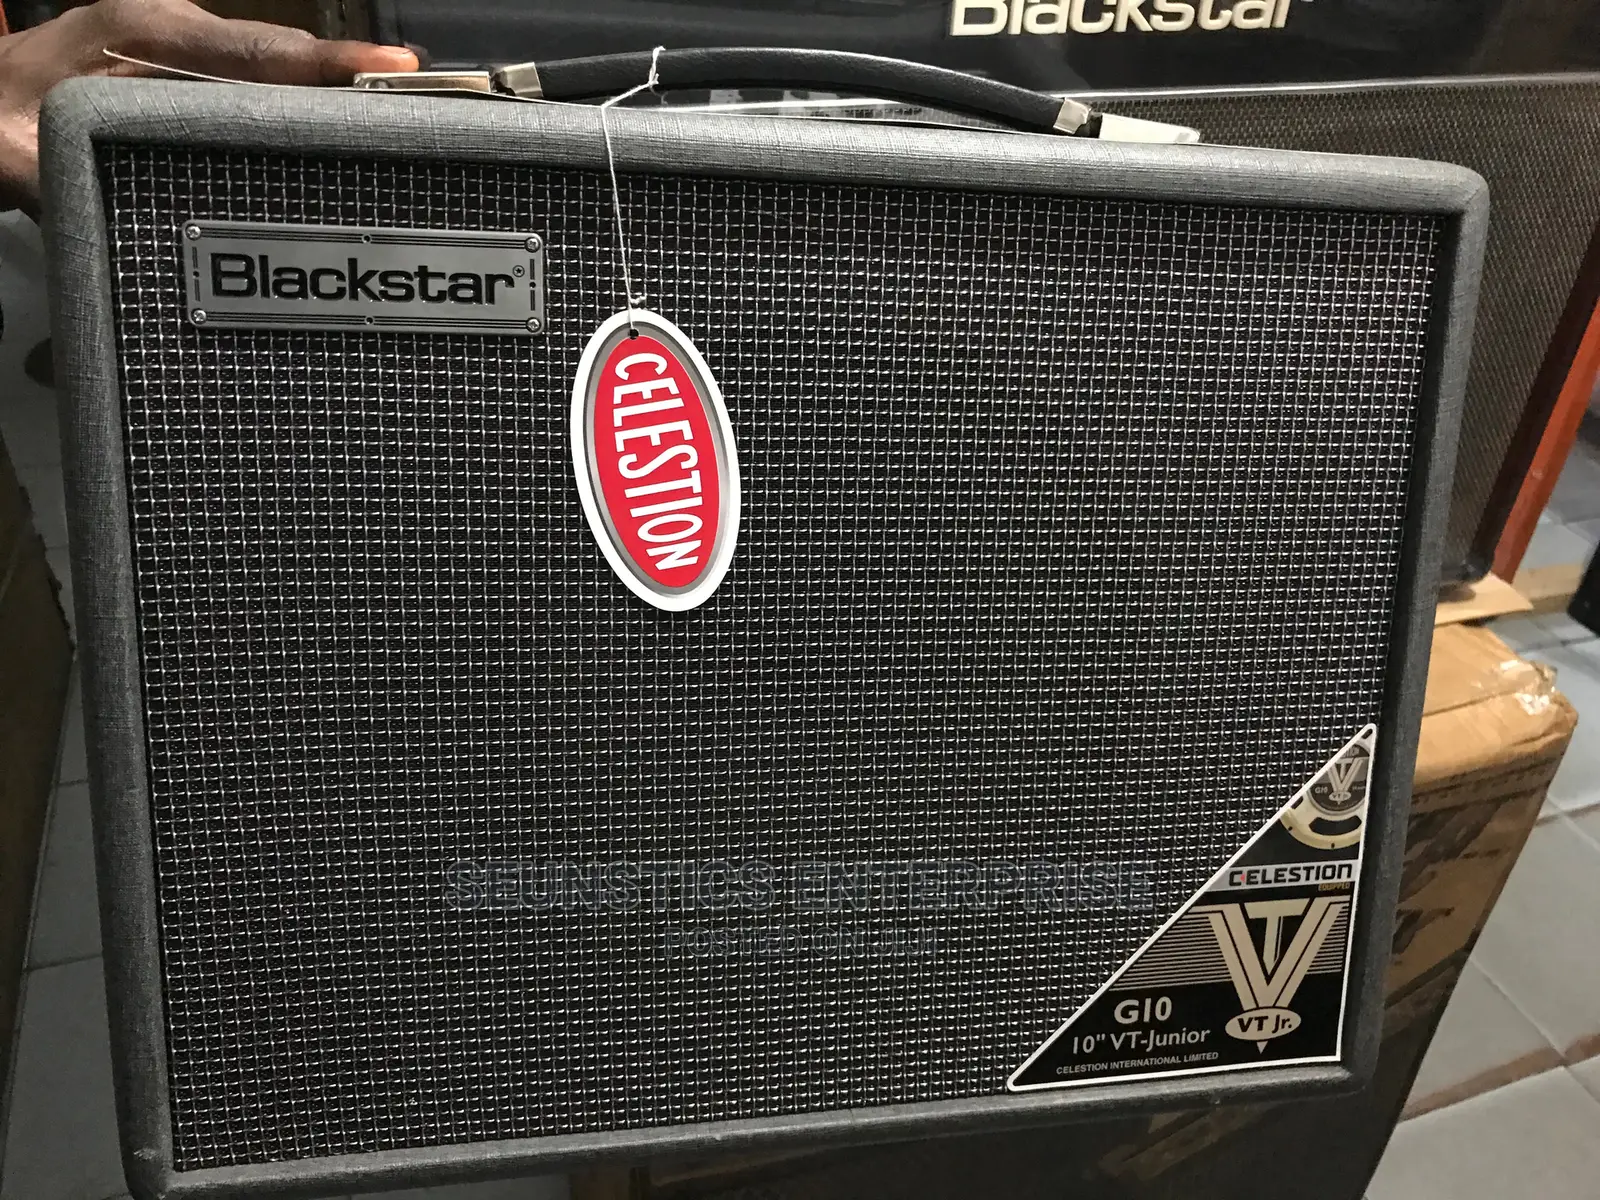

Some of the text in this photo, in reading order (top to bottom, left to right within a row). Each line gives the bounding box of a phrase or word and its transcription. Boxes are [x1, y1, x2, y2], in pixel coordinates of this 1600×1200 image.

[210, 252, 515, 305] Blackstar
[613, 353, 703, 570] CELESTION
[1229, 863, 1353, 887] CELESTION
[1114, 996, 1172, 1024] G10
[1237, 1014, 1293, 1034] VT Jr.
[1072, 1027, 1211, 1054] 10" VT-Junior
[1056, 1052, 1219, 1075] CELESTION INTERNATIONAL LIMITED
